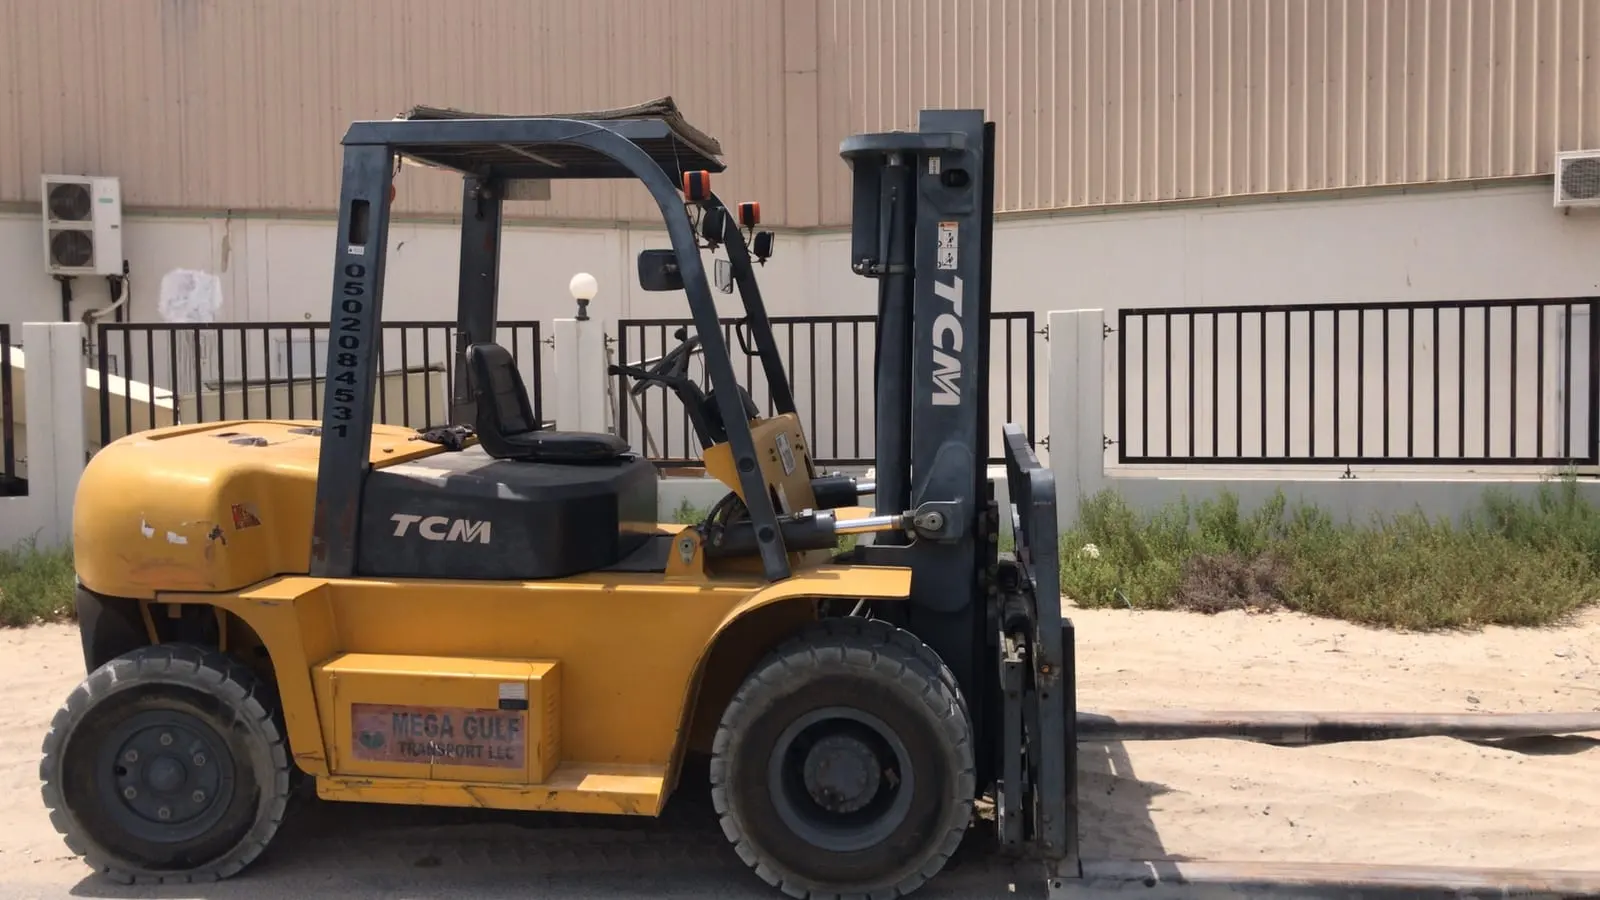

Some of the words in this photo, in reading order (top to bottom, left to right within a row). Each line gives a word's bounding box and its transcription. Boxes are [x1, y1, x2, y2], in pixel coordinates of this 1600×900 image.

[332, 263, 366, 438] 0502084531
[931, 275, 964, 406] TCM
[389, 513, 492, 544] TCM
[392, 712, 454, 738] MEGA
[463, 715, 520, 740] GULF
[398, 741, 484, 758] TRANSPORT
[488, 744, 515, 760] LLC
